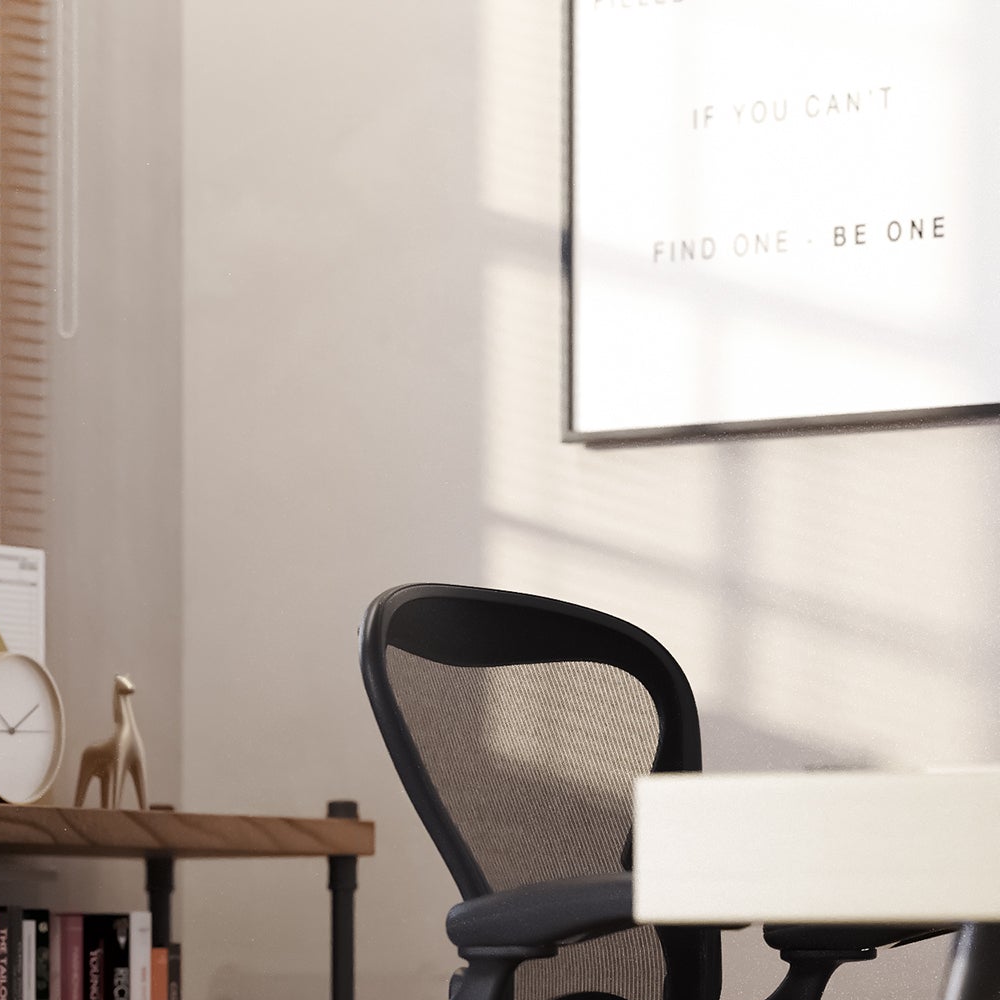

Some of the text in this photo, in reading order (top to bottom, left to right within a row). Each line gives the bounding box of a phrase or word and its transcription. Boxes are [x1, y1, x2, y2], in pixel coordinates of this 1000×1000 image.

[691, 86, 892, 130] IF YOU CAN'T
[652, 216, 946, 263] FIND ONE BE ONE
[0, 928, 8, 954] THE
